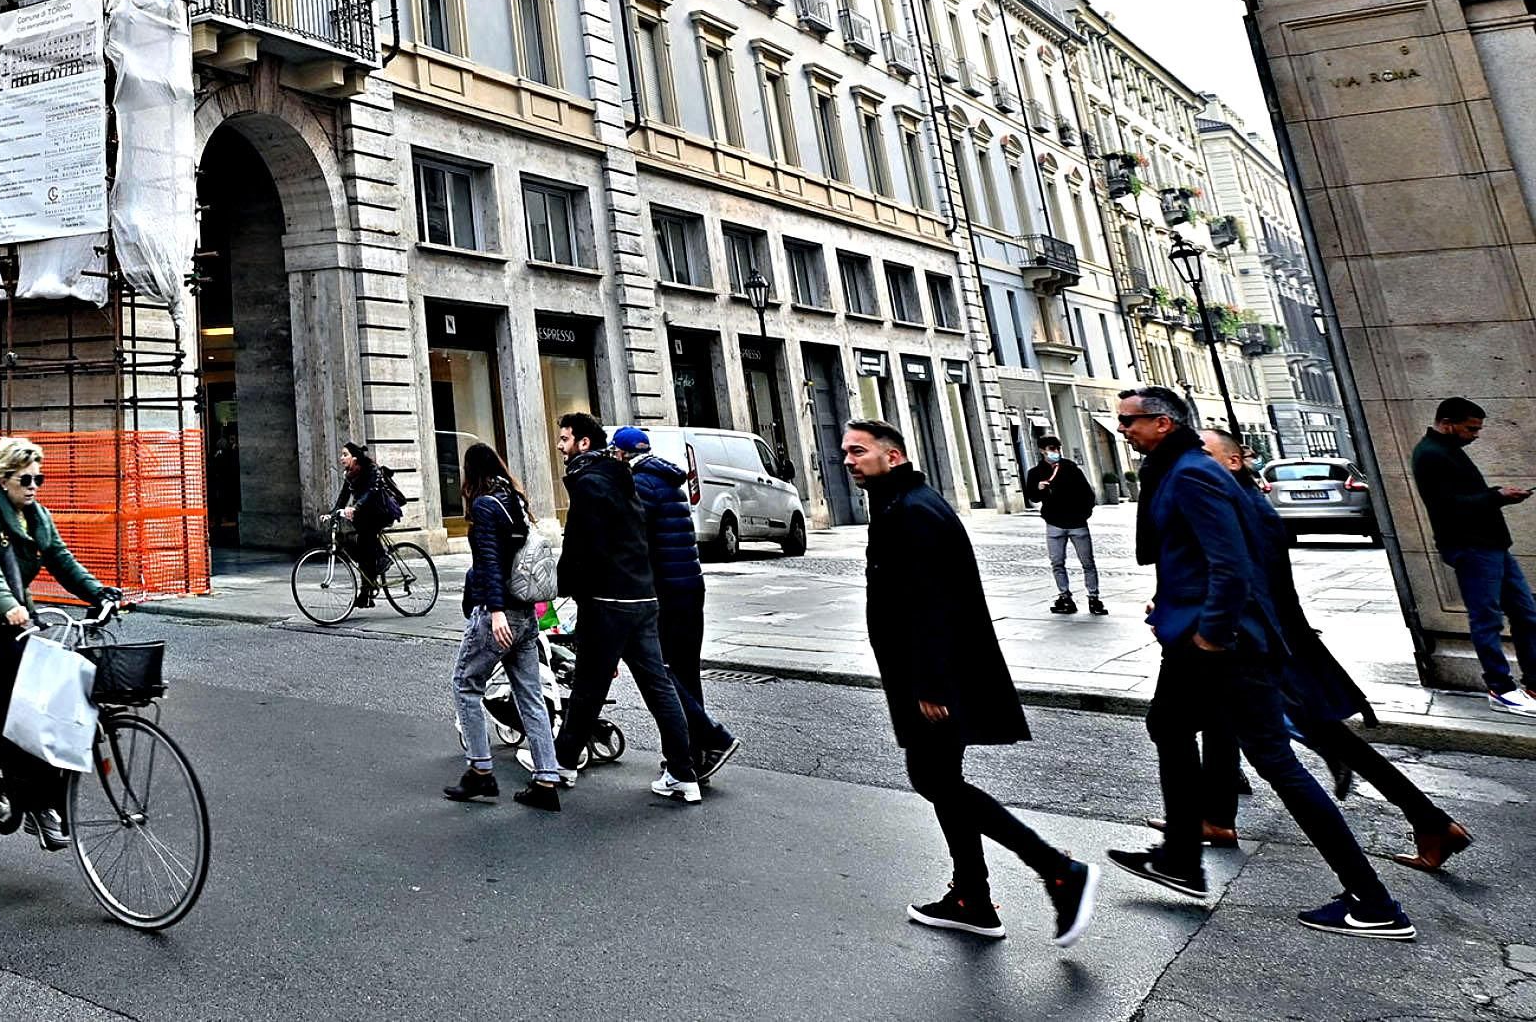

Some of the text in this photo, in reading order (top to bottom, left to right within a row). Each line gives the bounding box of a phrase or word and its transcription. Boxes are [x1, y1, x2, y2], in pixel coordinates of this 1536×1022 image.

[1328, 68, 1422, 88] VIA ROMA
[537, 327, 576, 341] ESPRESSO
